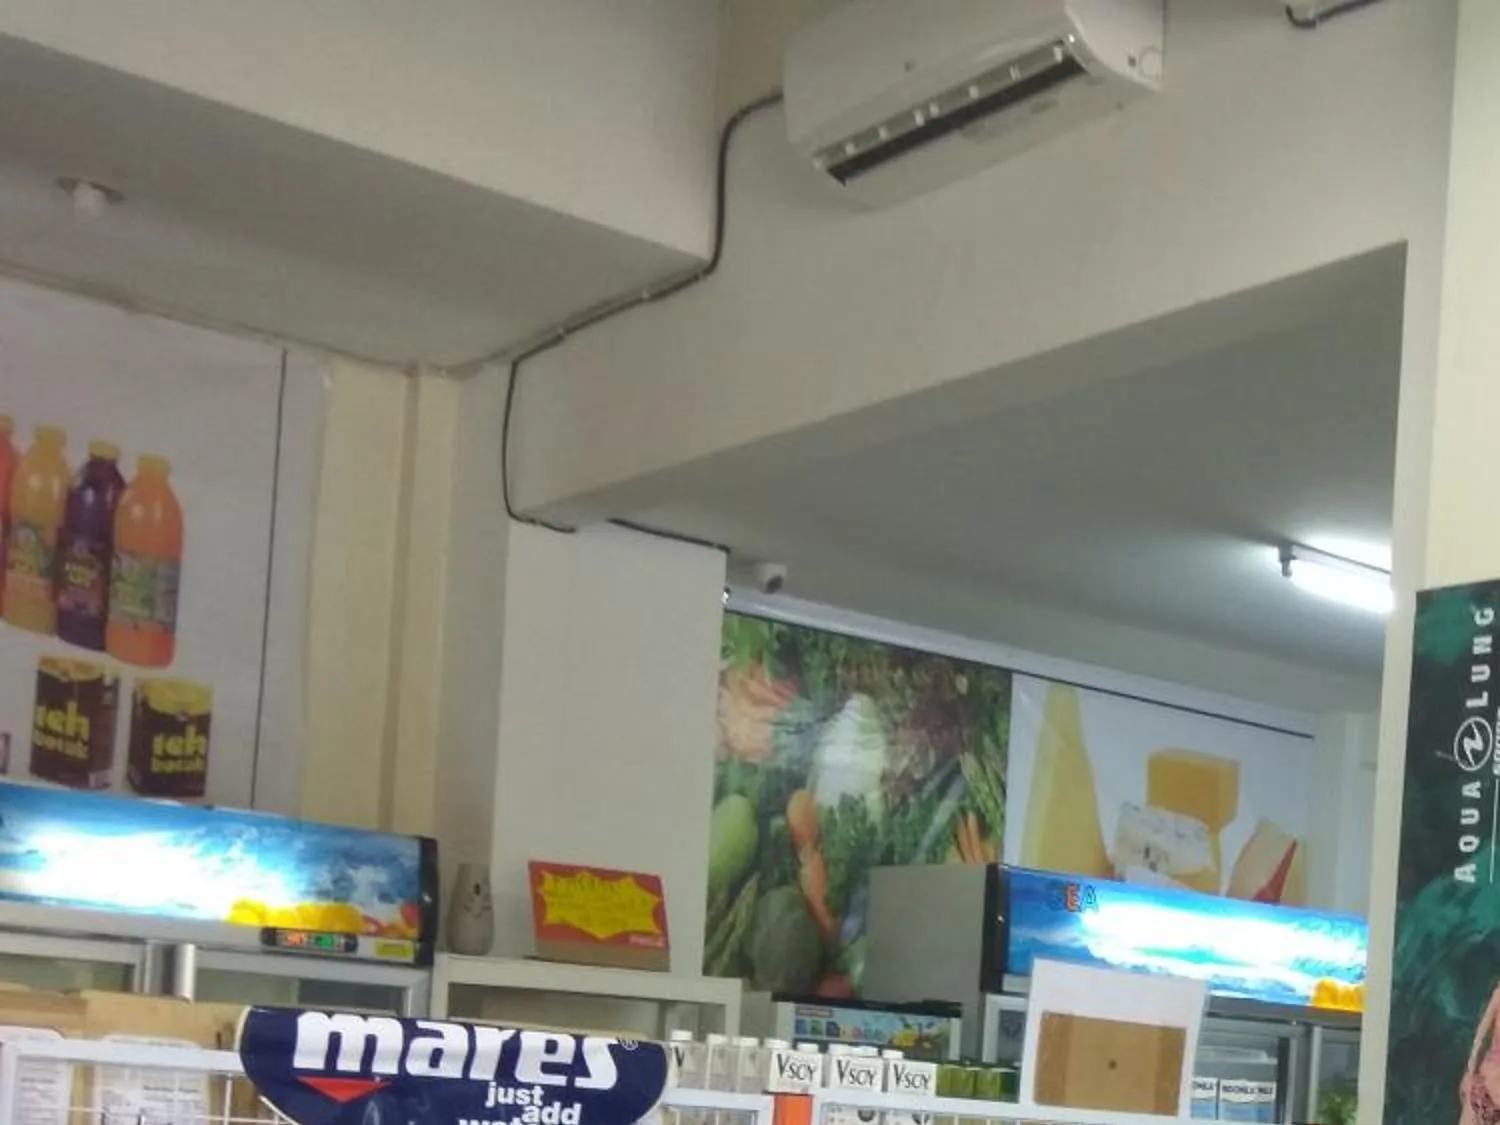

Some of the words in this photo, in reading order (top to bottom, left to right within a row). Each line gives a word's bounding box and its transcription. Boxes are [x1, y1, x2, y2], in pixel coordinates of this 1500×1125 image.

[1466, 605, 1495, 708] LUNG
[1453, 780, 1482, 884] AQUA
[293, 1010, 620, 1091] mares
[485, 1081, 544, 1109] just
